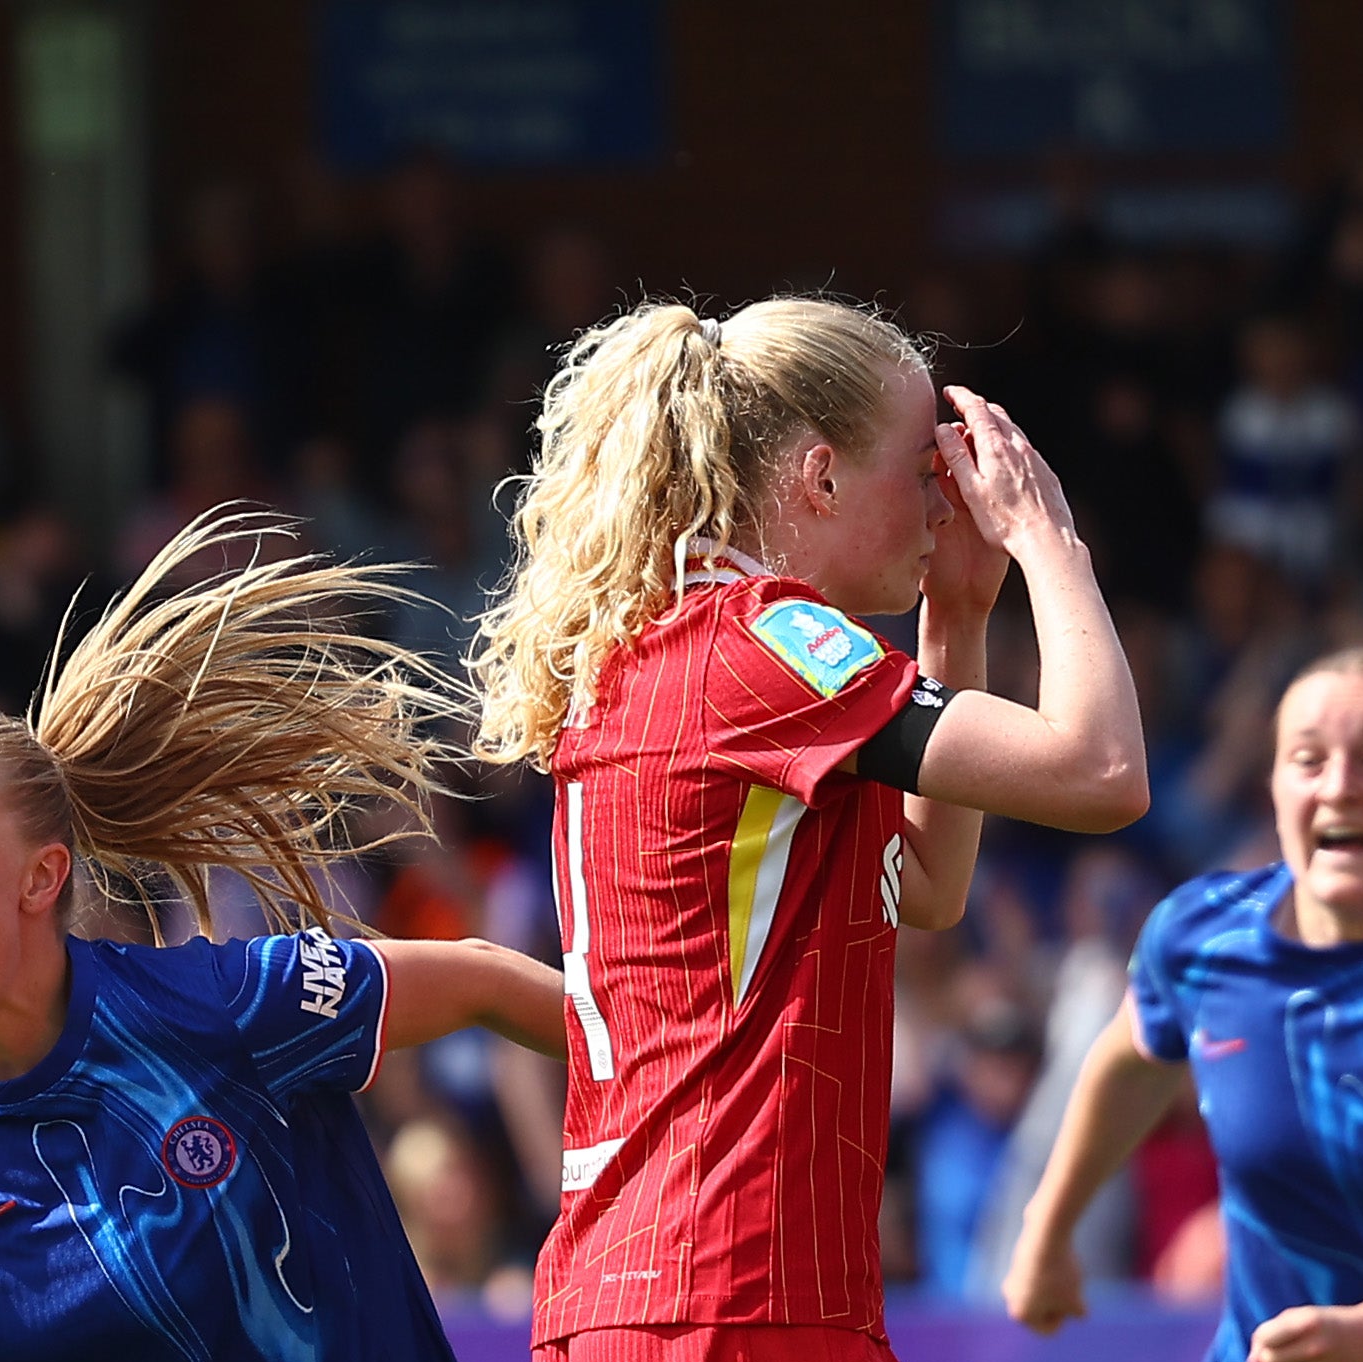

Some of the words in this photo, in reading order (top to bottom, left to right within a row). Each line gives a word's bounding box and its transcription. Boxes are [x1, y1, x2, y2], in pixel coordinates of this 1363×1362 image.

[300, 939, 326, 1014] LIVE
[306, 926, 347, 1019] NATIO
[169, 1121, 210, 1145] CHELSEA
